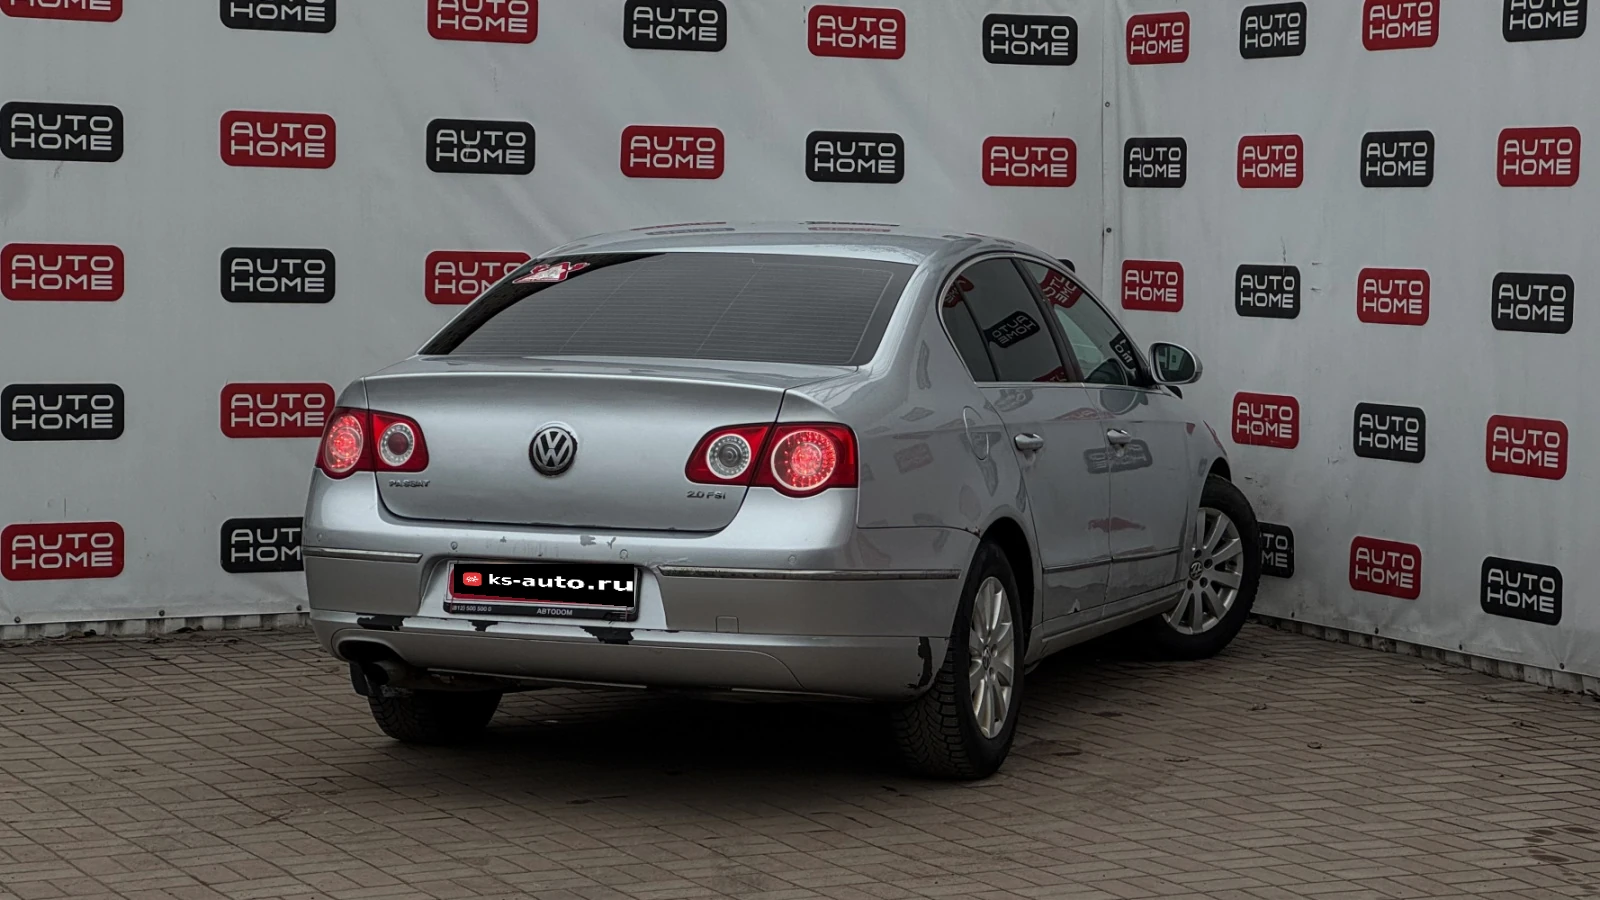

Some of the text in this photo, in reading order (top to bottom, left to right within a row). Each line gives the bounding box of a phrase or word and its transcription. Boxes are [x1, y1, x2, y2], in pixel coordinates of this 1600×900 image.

[230, 2, 325, 22] HOME
[438, 0, 529, 15] AUTO
[633, 6, 718, 24] AUTO
[1370, 1, 1433, 21] AUTO
[437, 14, 528, 33] HOME
[817, 15, 897, 33] AUTO
[1245, 13, 1301, 31] AUTO
[1509, 10, 1578, 30] HOME
[633, 24, 717, 41] HOME
[991, 24, 1069, 39] AUTO
[1132, 22, 1184, 38] AUTO
[1369, 20, 1431, 40] HOME
[817, 32, 896, 49] HOME
[1130, 39, 1183, 55] HOME
[1245, 30, 1299, 48] HOME
[991, 40, 1068, 56] HOME
[11, 113, 113, 132] AUTO
[231, 122, 326, 140] AUTO
[11, 132, 112, 151] HOME
[436, 129, 526, 146] AUTO
[631, 136, 716, 152] AUTO
[231, 140, 325, 158] HOME
[436, 147, 525, 164] HOME
[815, 141, 896, 157] AUTO
[991, 146, 1068, 161] AUTO
[1130, 147, 1181, 161] AUTO
[1243, 145, 1297, 160] AUTO
[1366, 142, 1428, 158] AUTO
[1504, 139, 1573, 155] AUTO
[630, 153, 714, 169] HOME
[814, 158, 895, 173] HOME
[991, 162, 1067, 177] HOME
[1366, 160, 1426, 176] HOME
[1503, 158, 1571, 175] HOME
[1129, 164, 1180, 178] HOME
[1242, 163, 1296, 177] HOME
[12, 255, 114, 271] AUTO
[231, 258, 326, 274] AUTO
[12, 273, 112, 290] HOME
[231, 276, 324, 292] HOME
[1125, 270, 1178, 285] AUTO
[1241, 275, 1295, 291] AUTO
[435, 279, 491, 294] HO
[1125, 286, 1177, 302] HOME
[1363, 279, 1423, 296] AUTO
[1499, 284, 1566, 302] AUTO
[1240, 292, 1293, 308] HOME
[1363, 297, 1422, 314] HOME
[1498, 303, 1565, 322] HOME
[12, 395, 114, 410] AUTO
[231, 394, 325, 409] AUTO
[231, 412, 324, 427] HOME
[1237, 402, 1293, 421] AUTO
[12, 413, 113, 429] HOME
[1237, 419, 1292, 438] HOME
[1359, 413, 1419, 433] AUTO
[1359, 431, 1418, 452] HOME
[1493, 426, 1560, 448] AUTO
[1492, 445, 1558, 468] HOME
[12, 533, 114, 551] AUTO
[231, 528, 301, 544] AUT
[1259, 532, 1288, 550] TO
[12, 551, 112, 570] HOME
[231, 546, 301, 562] HOM
[1261, 550, 1288, 568] ME
[1356, 547, 1415, 570] AUTO
[1355, 565, 1413, 589] HOME
[1488, 568, 1555, 594] AUTO
[1487, 587, 1554, 613] HOME
